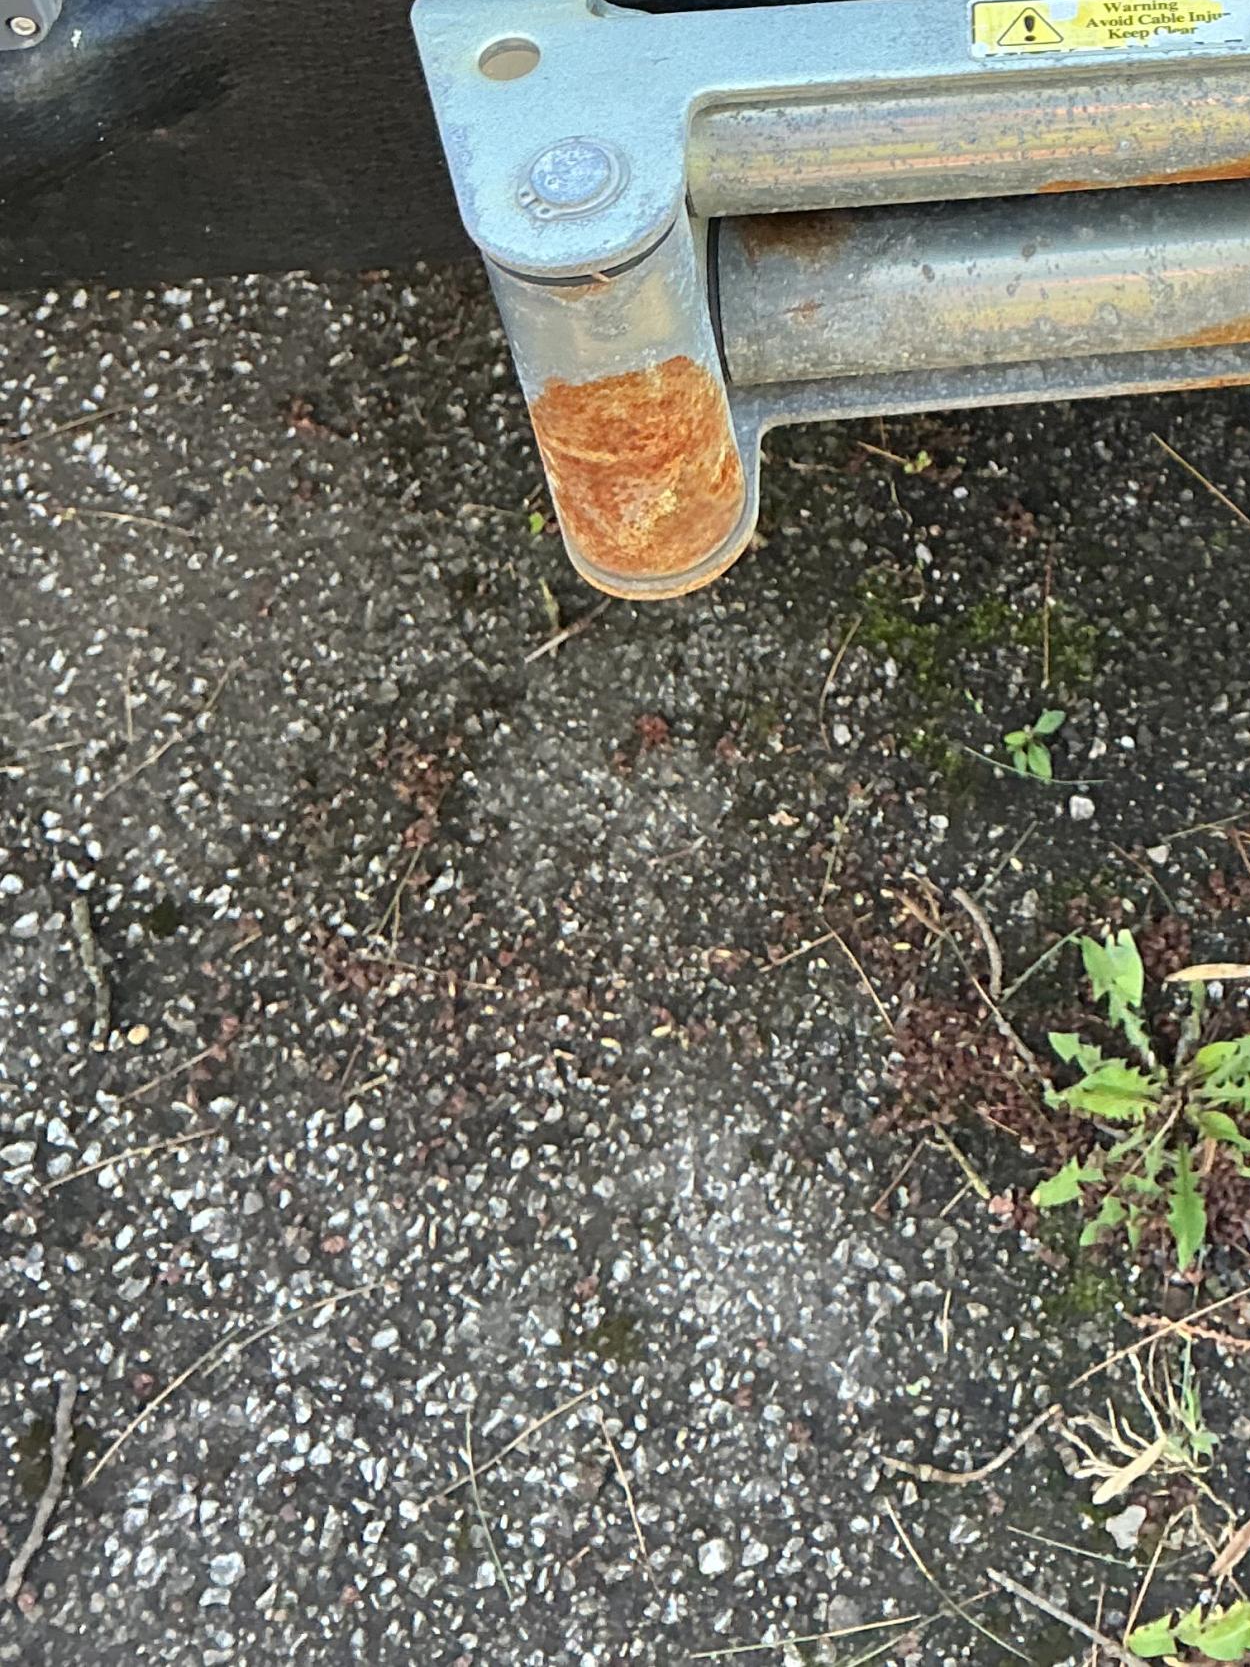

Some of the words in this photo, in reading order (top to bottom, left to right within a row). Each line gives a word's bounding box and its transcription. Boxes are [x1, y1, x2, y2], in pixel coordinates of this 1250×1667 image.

[1103, 0, 1179, 14] Warning
[1086, 15, 1134, 28] Avoid
[1138, 12, 1186, 26] Cable
[1189, 10, 1231, 24] Inju
[1108, 28, 1150, 41] Keep
